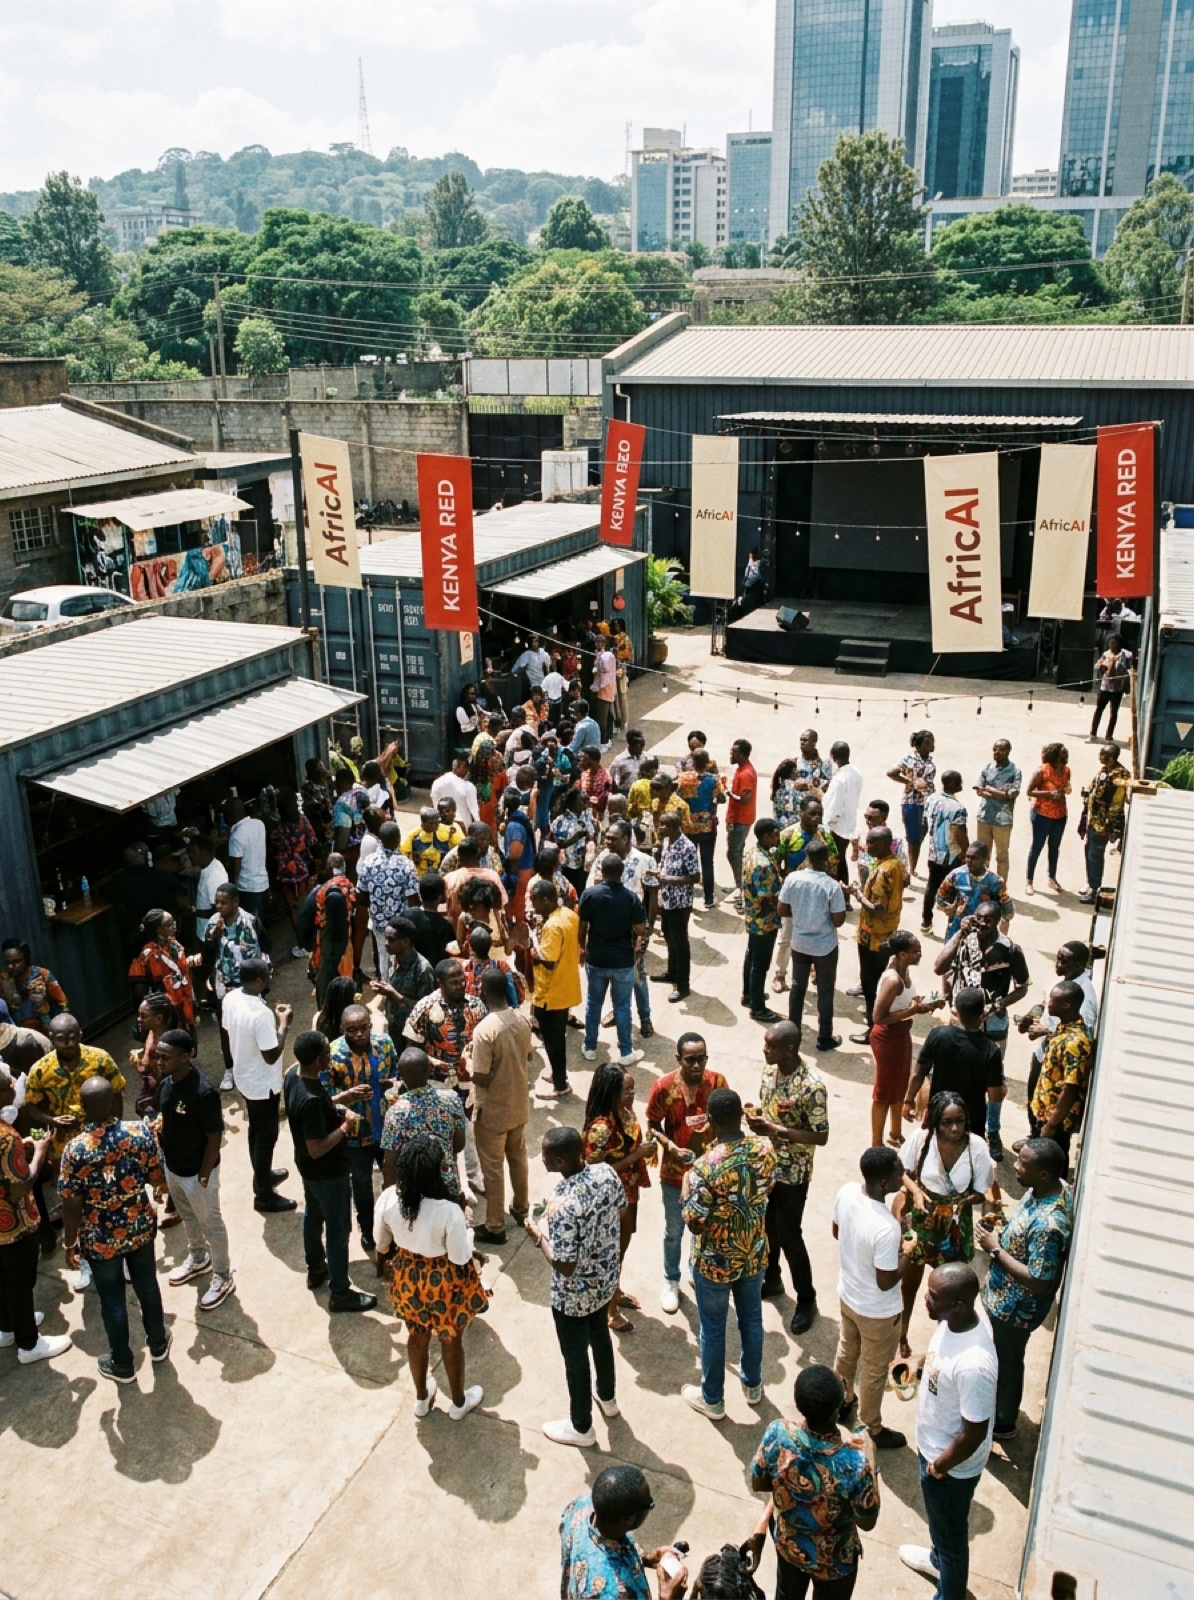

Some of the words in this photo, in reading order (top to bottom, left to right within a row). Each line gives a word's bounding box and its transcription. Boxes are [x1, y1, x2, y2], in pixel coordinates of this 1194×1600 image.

[1117, 448, 1137, 496] RED
[314, 462, 349, 567] AfricAI
[437, 479, 456, 527] RED
[610, 478, 627, 531] KENYA
[695, 508, 734, 521] AfricAI
[1039, 518, 1085, 532] AfricAI
[944, 487, 983, 625] AfricAI
[1116, 500, 1136, 578] KENYA
[440, 532, 461, 611] KENYA
